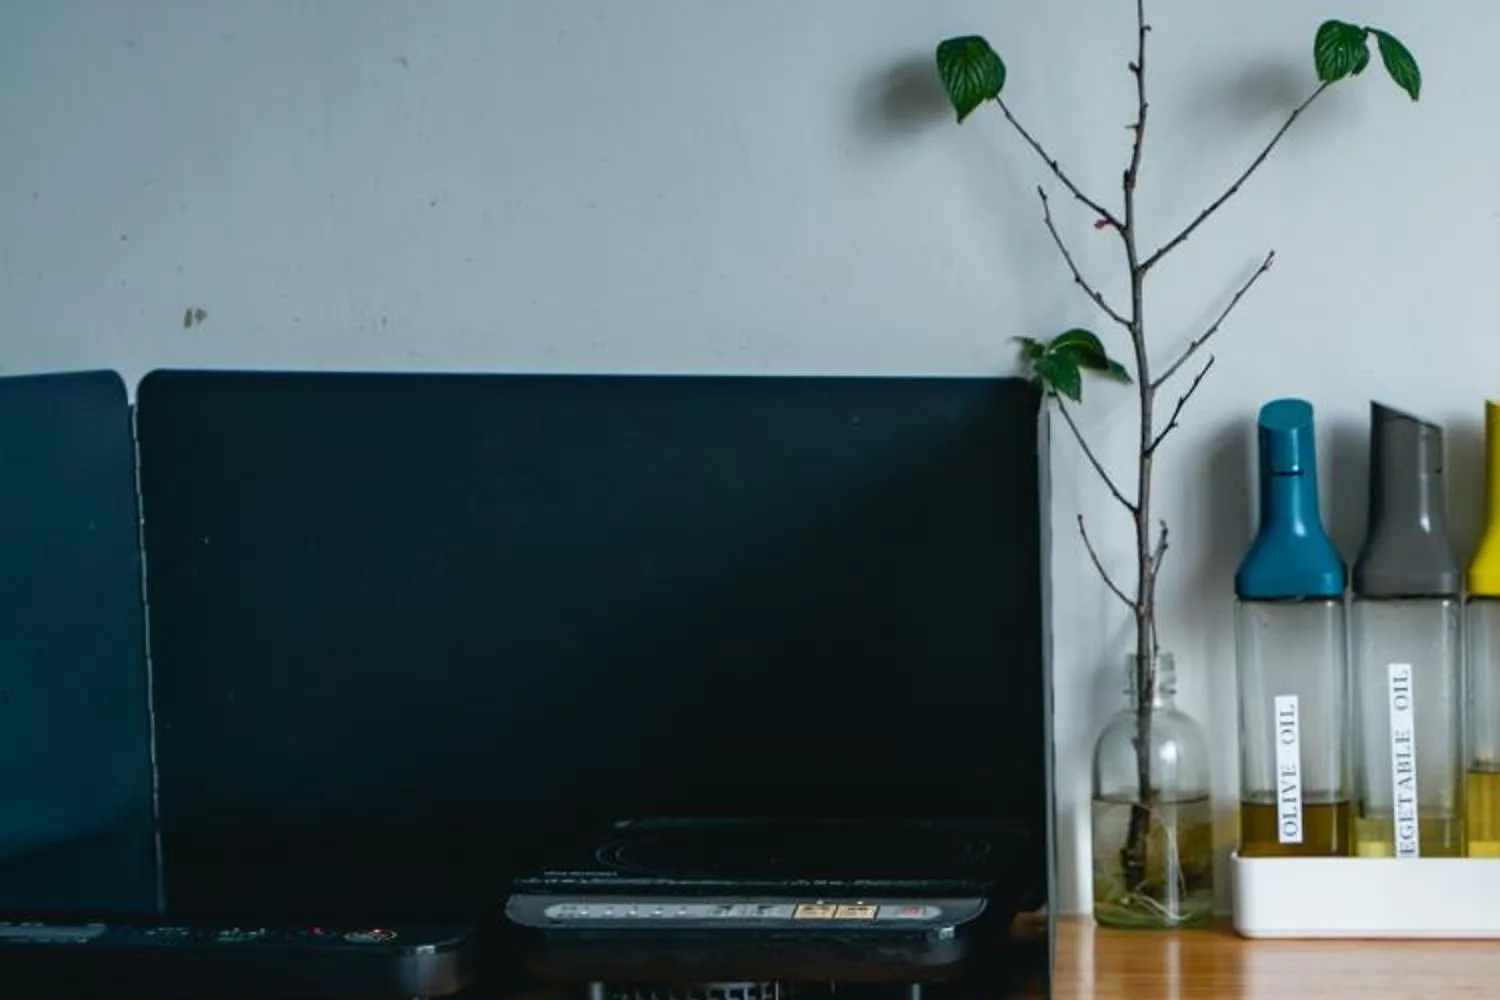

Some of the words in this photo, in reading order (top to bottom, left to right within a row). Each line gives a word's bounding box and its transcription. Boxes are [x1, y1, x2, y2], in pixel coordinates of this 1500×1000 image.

[1392, 669, 1410, 711] OIL
[1279, 703, 1297, 745] OIL
[1282, 765, 1300, 838] OLIVE
[1394, 730, 1415, 858] EGETABLE
